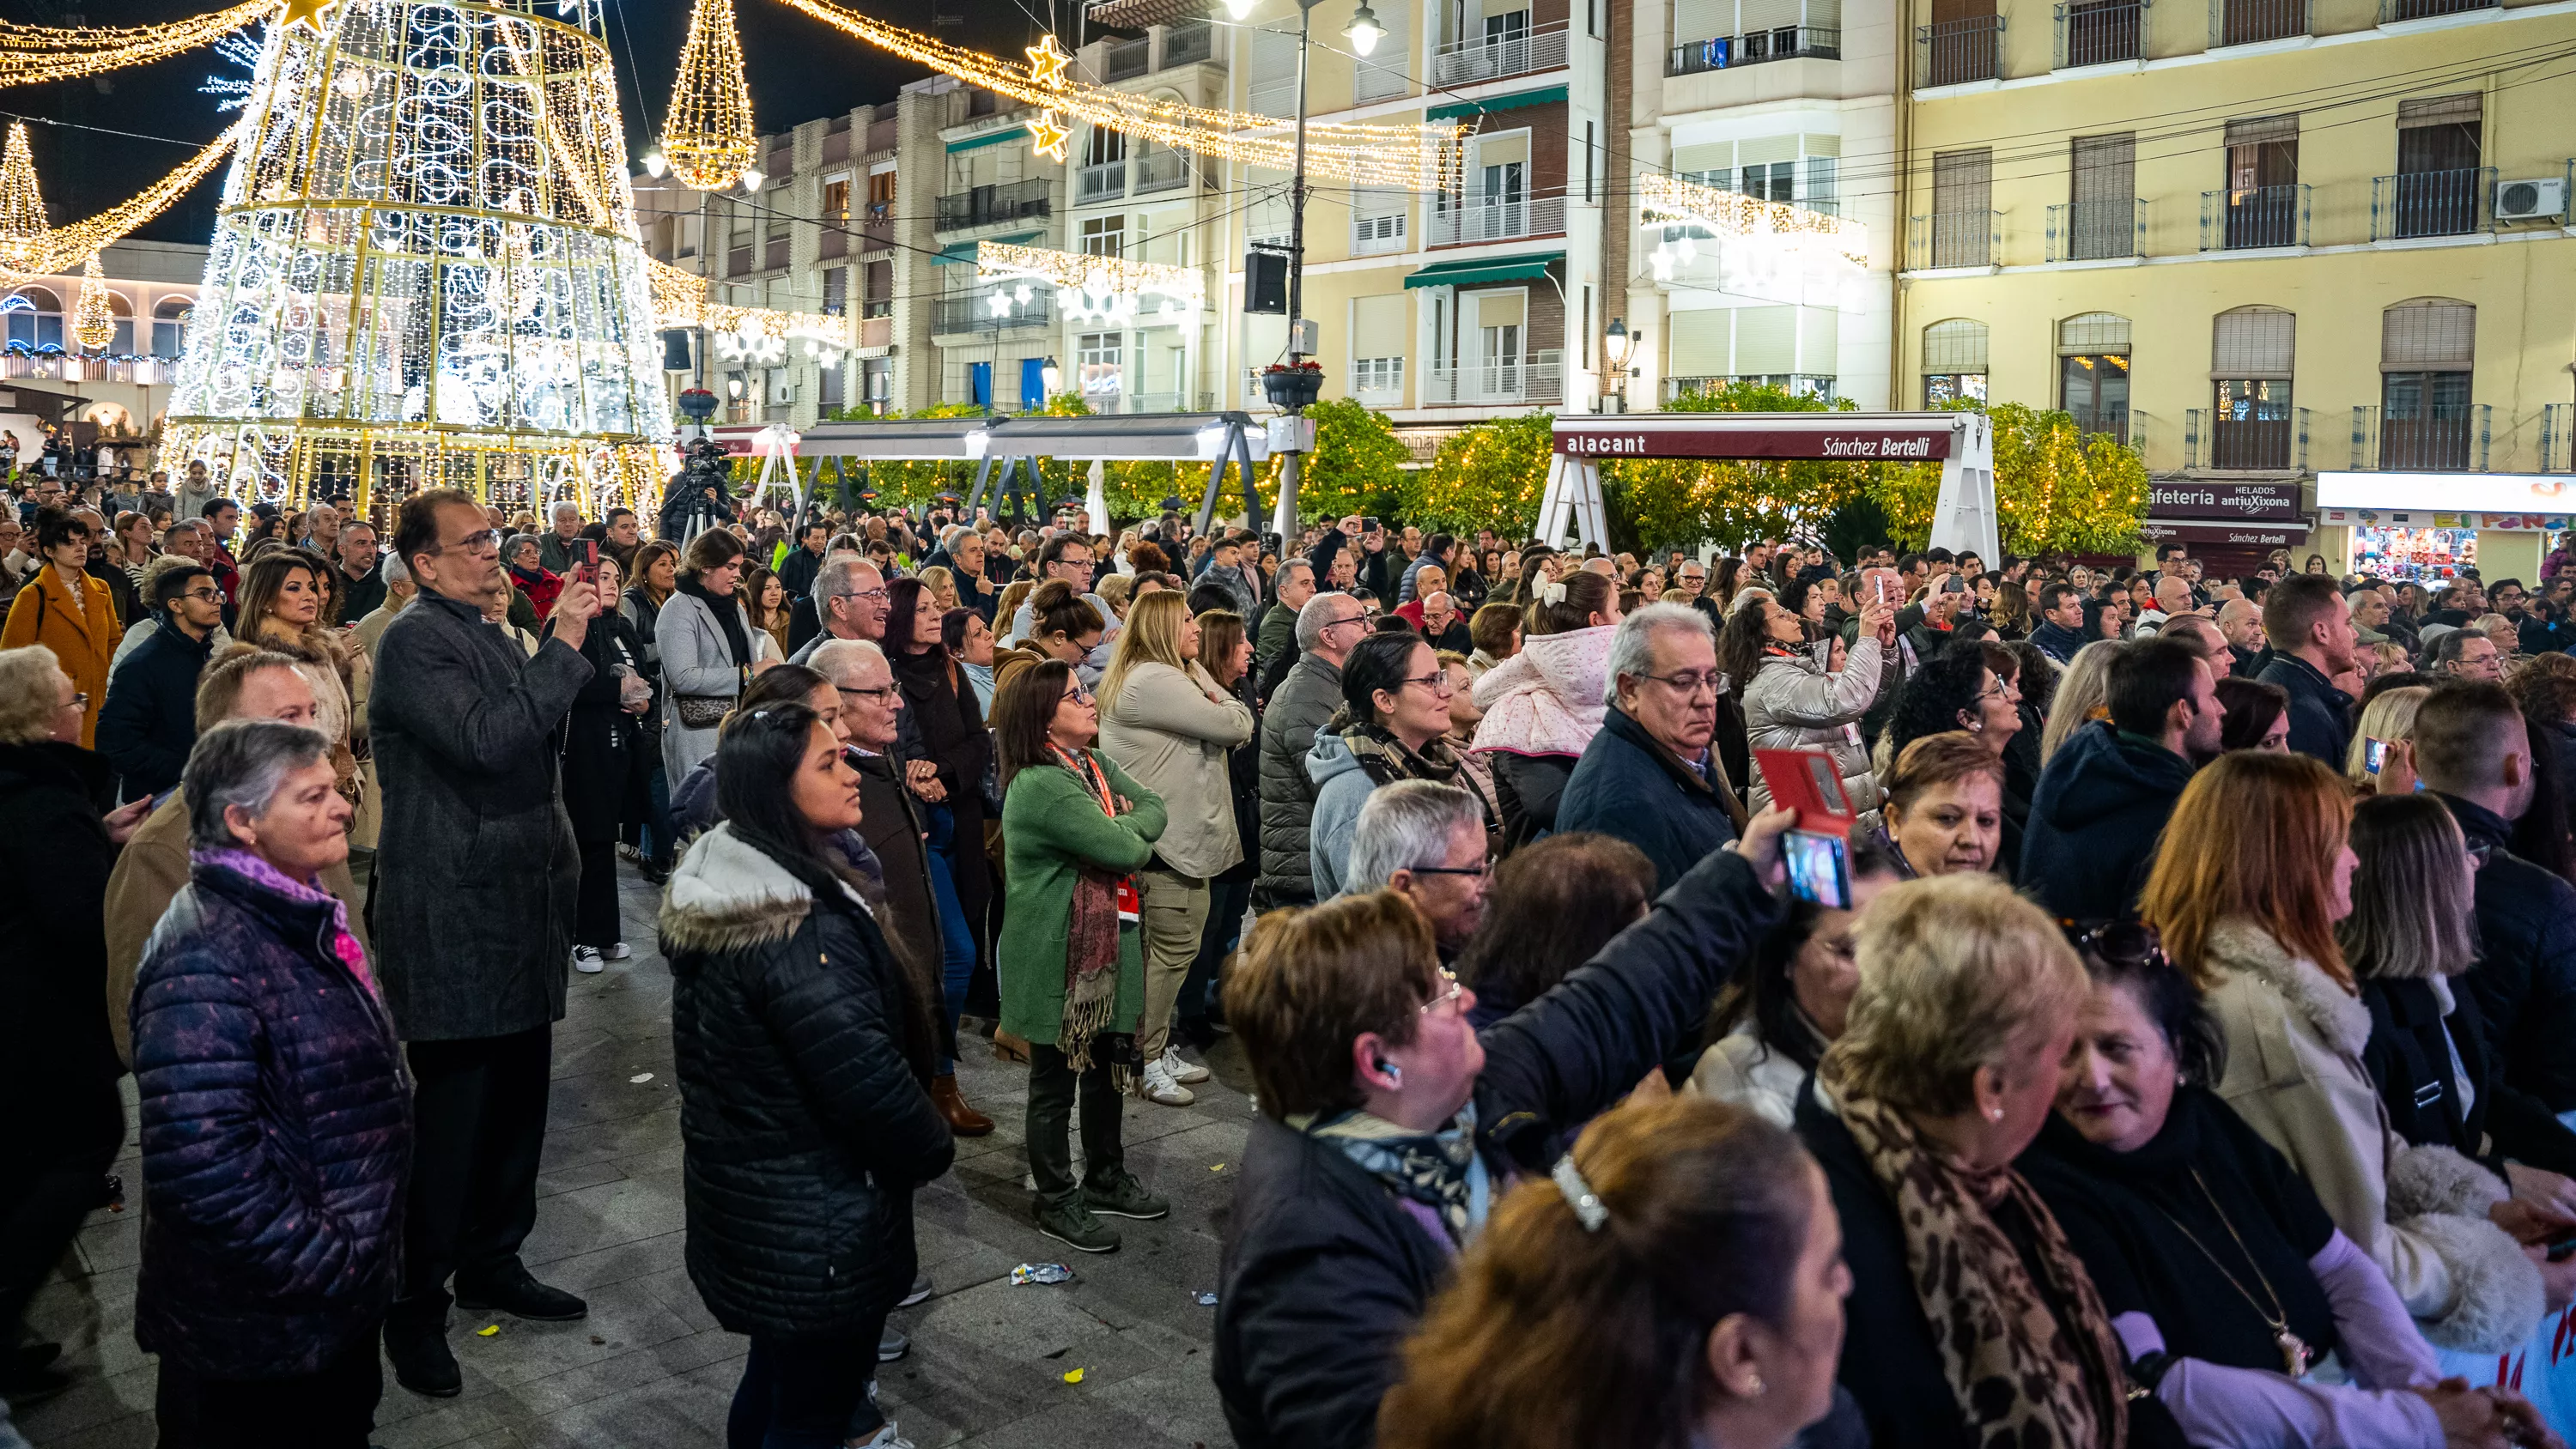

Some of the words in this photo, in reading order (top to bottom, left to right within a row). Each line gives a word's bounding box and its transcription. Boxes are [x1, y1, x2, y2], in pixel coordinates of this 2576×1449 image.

[1567, 435, 1645, 452] alacant
[1822, 437, 1878, 456] Sánchez
[1880, 437, 1930, 457] Bertelli
[2149, 488, 2215, 505] afetería
[2235, 486, 2275, 494] HELADOS
[2221, 495, 2290, 510] antiuXixona
[2141, 527, 2177, 536] ntiuXixona
[2228, 532, 2258, 543] Sánchez
[2260, 534, 2286, 543] Bertelli
